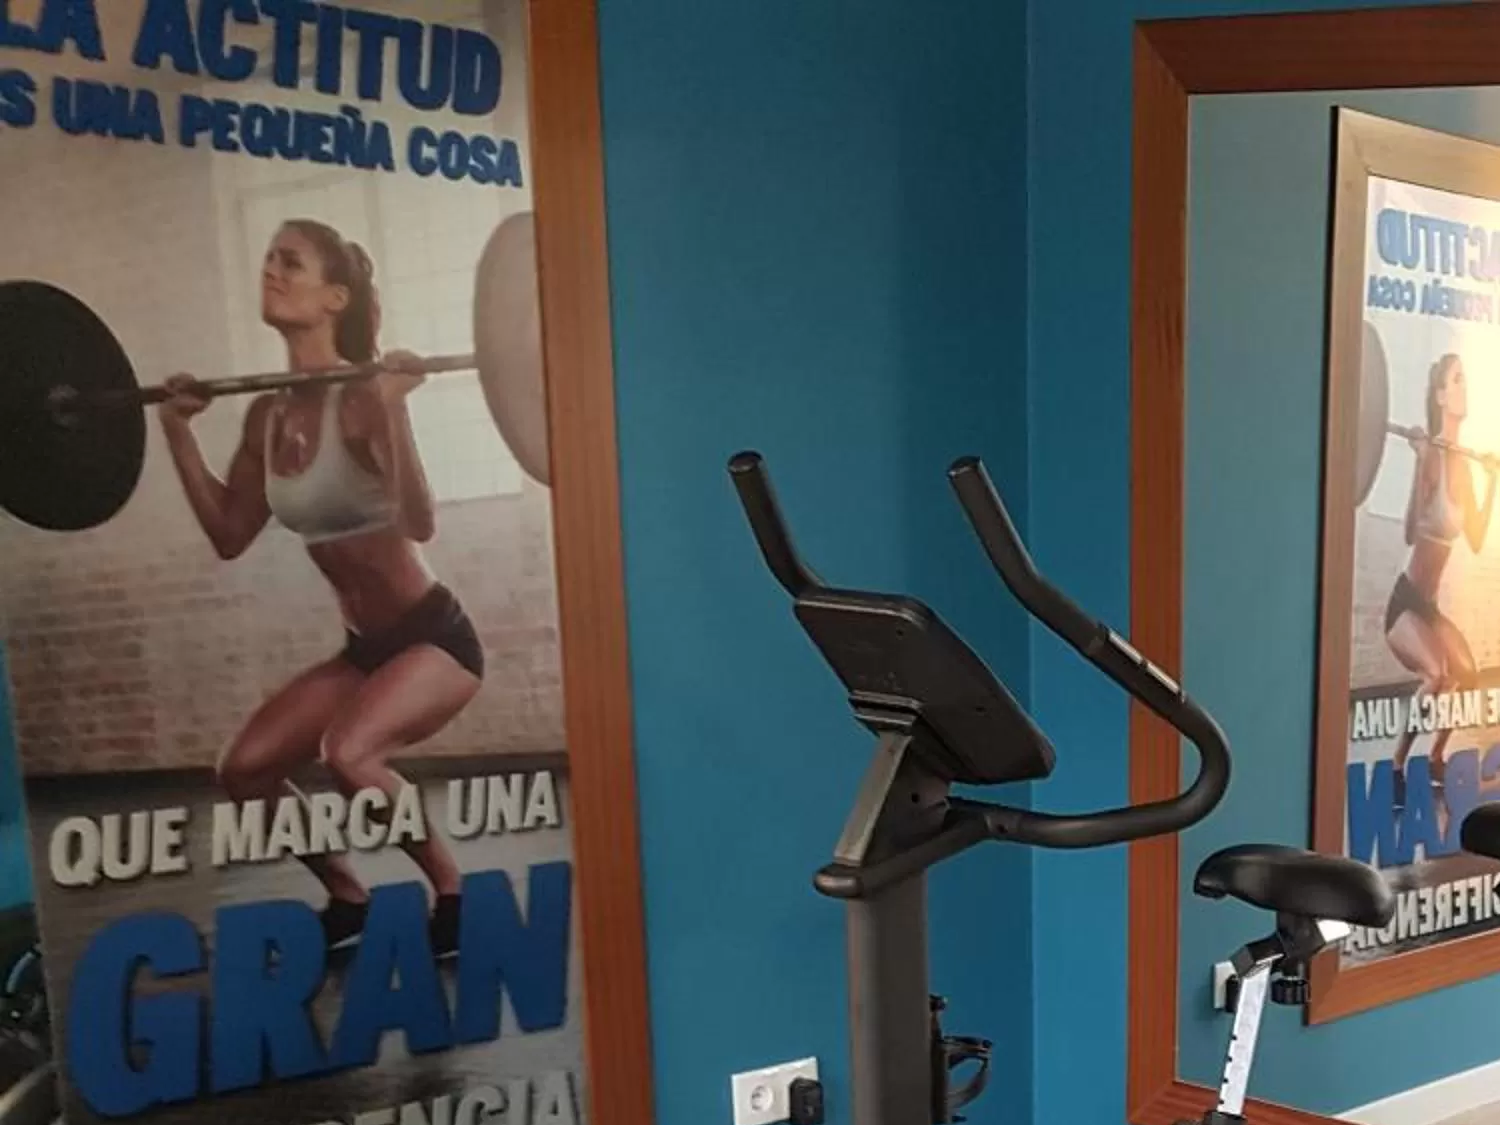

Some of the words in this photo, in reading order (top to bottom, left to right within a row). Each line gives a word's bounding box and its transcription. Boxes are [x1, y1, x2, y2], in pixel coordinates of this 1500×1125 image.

[132, 0, 502, 115] ACTITUD
[0, 69, 36, 127] S
[53, 76, 164, 144] UNA
[180, 93, 395, 172] PEQUEÑA
[408, 126, 522, 188] COSA
[49, 808, 188, 888] QUE
[210, 782, 426, 866] MARCA
[447, 771, 561, 838] UNA
[68, 861, 572, 1120] GRAN
